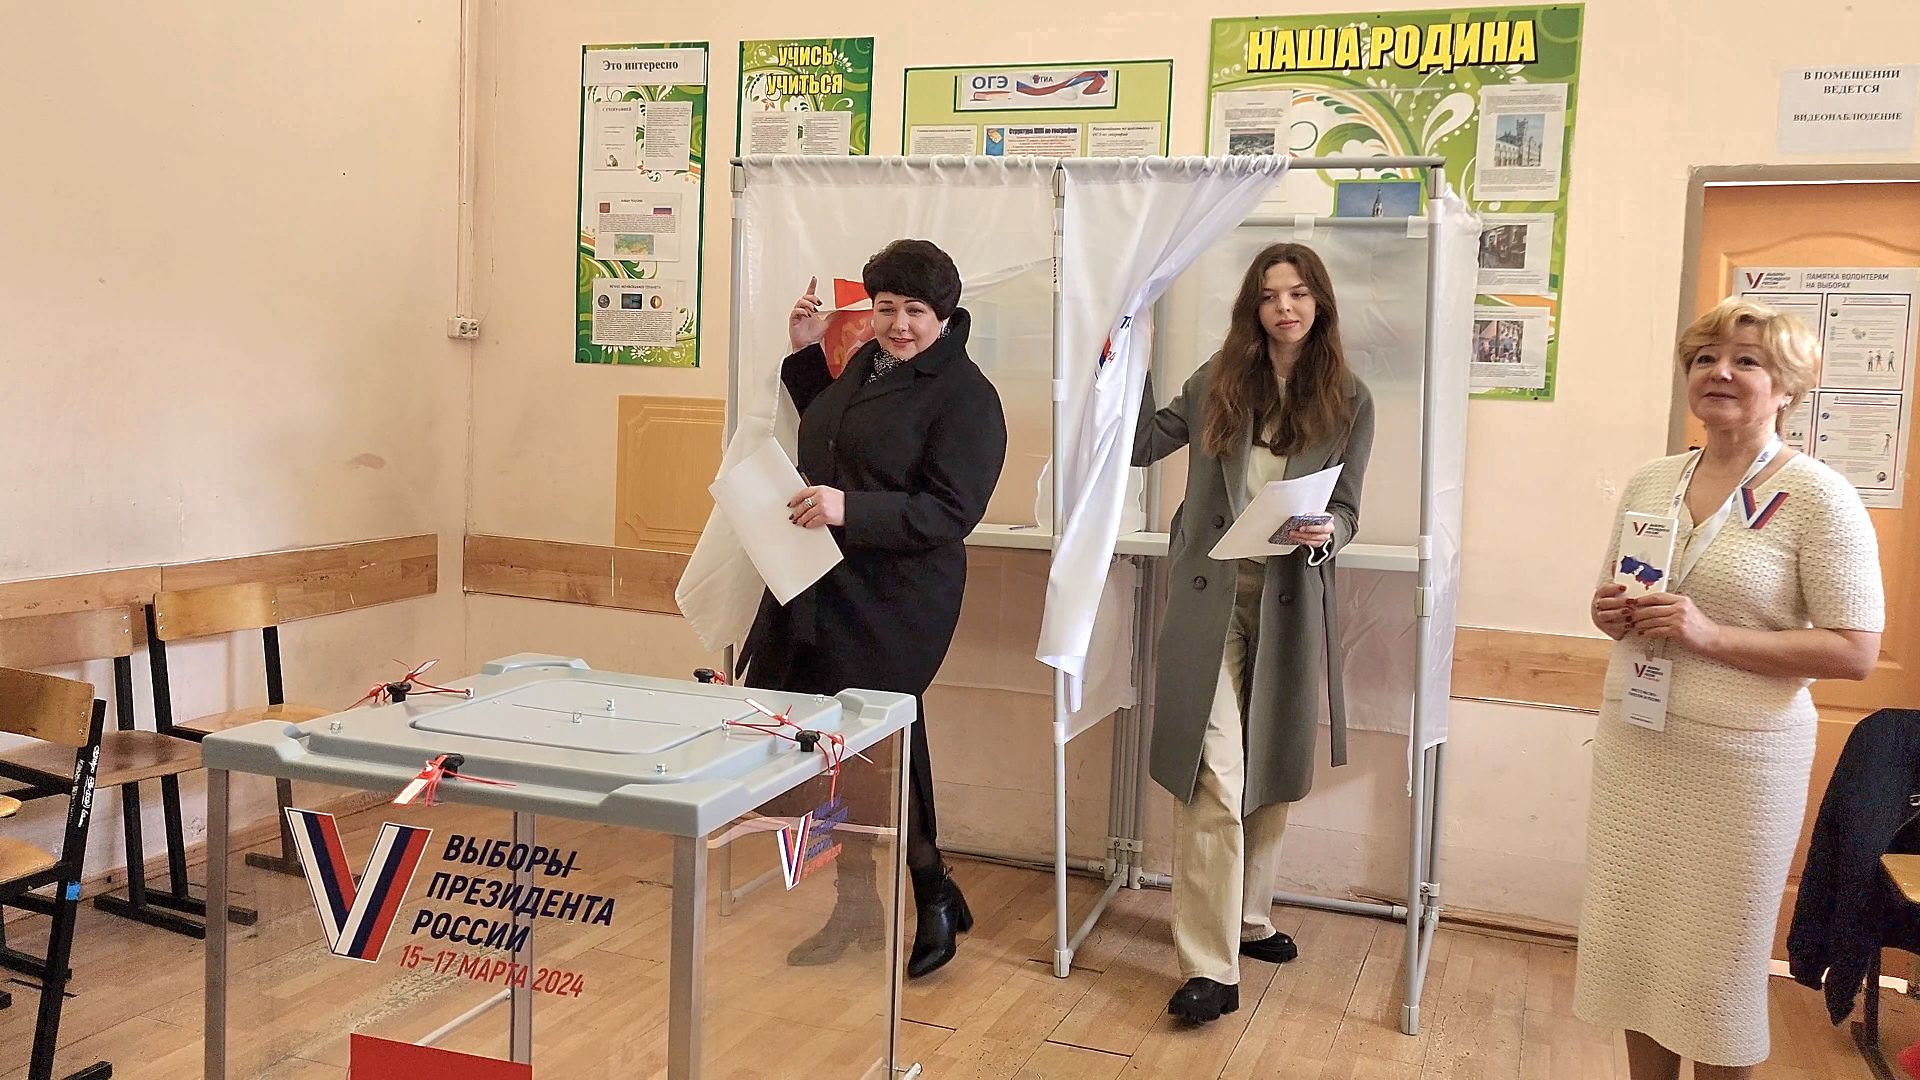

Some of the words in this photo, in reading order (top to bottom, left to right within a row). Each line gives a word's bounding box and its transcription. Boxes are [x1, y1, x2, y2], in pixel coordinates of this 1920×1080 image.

[777, 45, 834, 67] УЧИСЬ
[1247, 27, 1362, 73] НАША
[1369, 20, 1539, 75] РОДИНА
[602, 60, 622, 71] Это
[625, 60, 679, 72] интересно
[1803, 71, 1811, 80] В
[1814, 70, 1900, 80] ПОМЕЩЕНИИ
[767, 73, 843, 95] УЧИТЬСЯ
[972, 76, 1008, 89] ОГЭ
[1823, 84, 1880, 94] ВЕДЕТСЯ
[1793, 112, 1903, 122] ВИДЕОНАБЛЮДЕНИЕ
[1841, 272, 1889, 280] ВОЛОНТЕРАМ
[442, 834, 578, 879] ВЫБОРЫ
[426, 872, 616, 926] ПРЕЗИДЕНТА
[411, 909, 531, 953] РОССИИ
[457, 956, 529, 988] МАРТА
[532, 968, 584, 998] 2024
